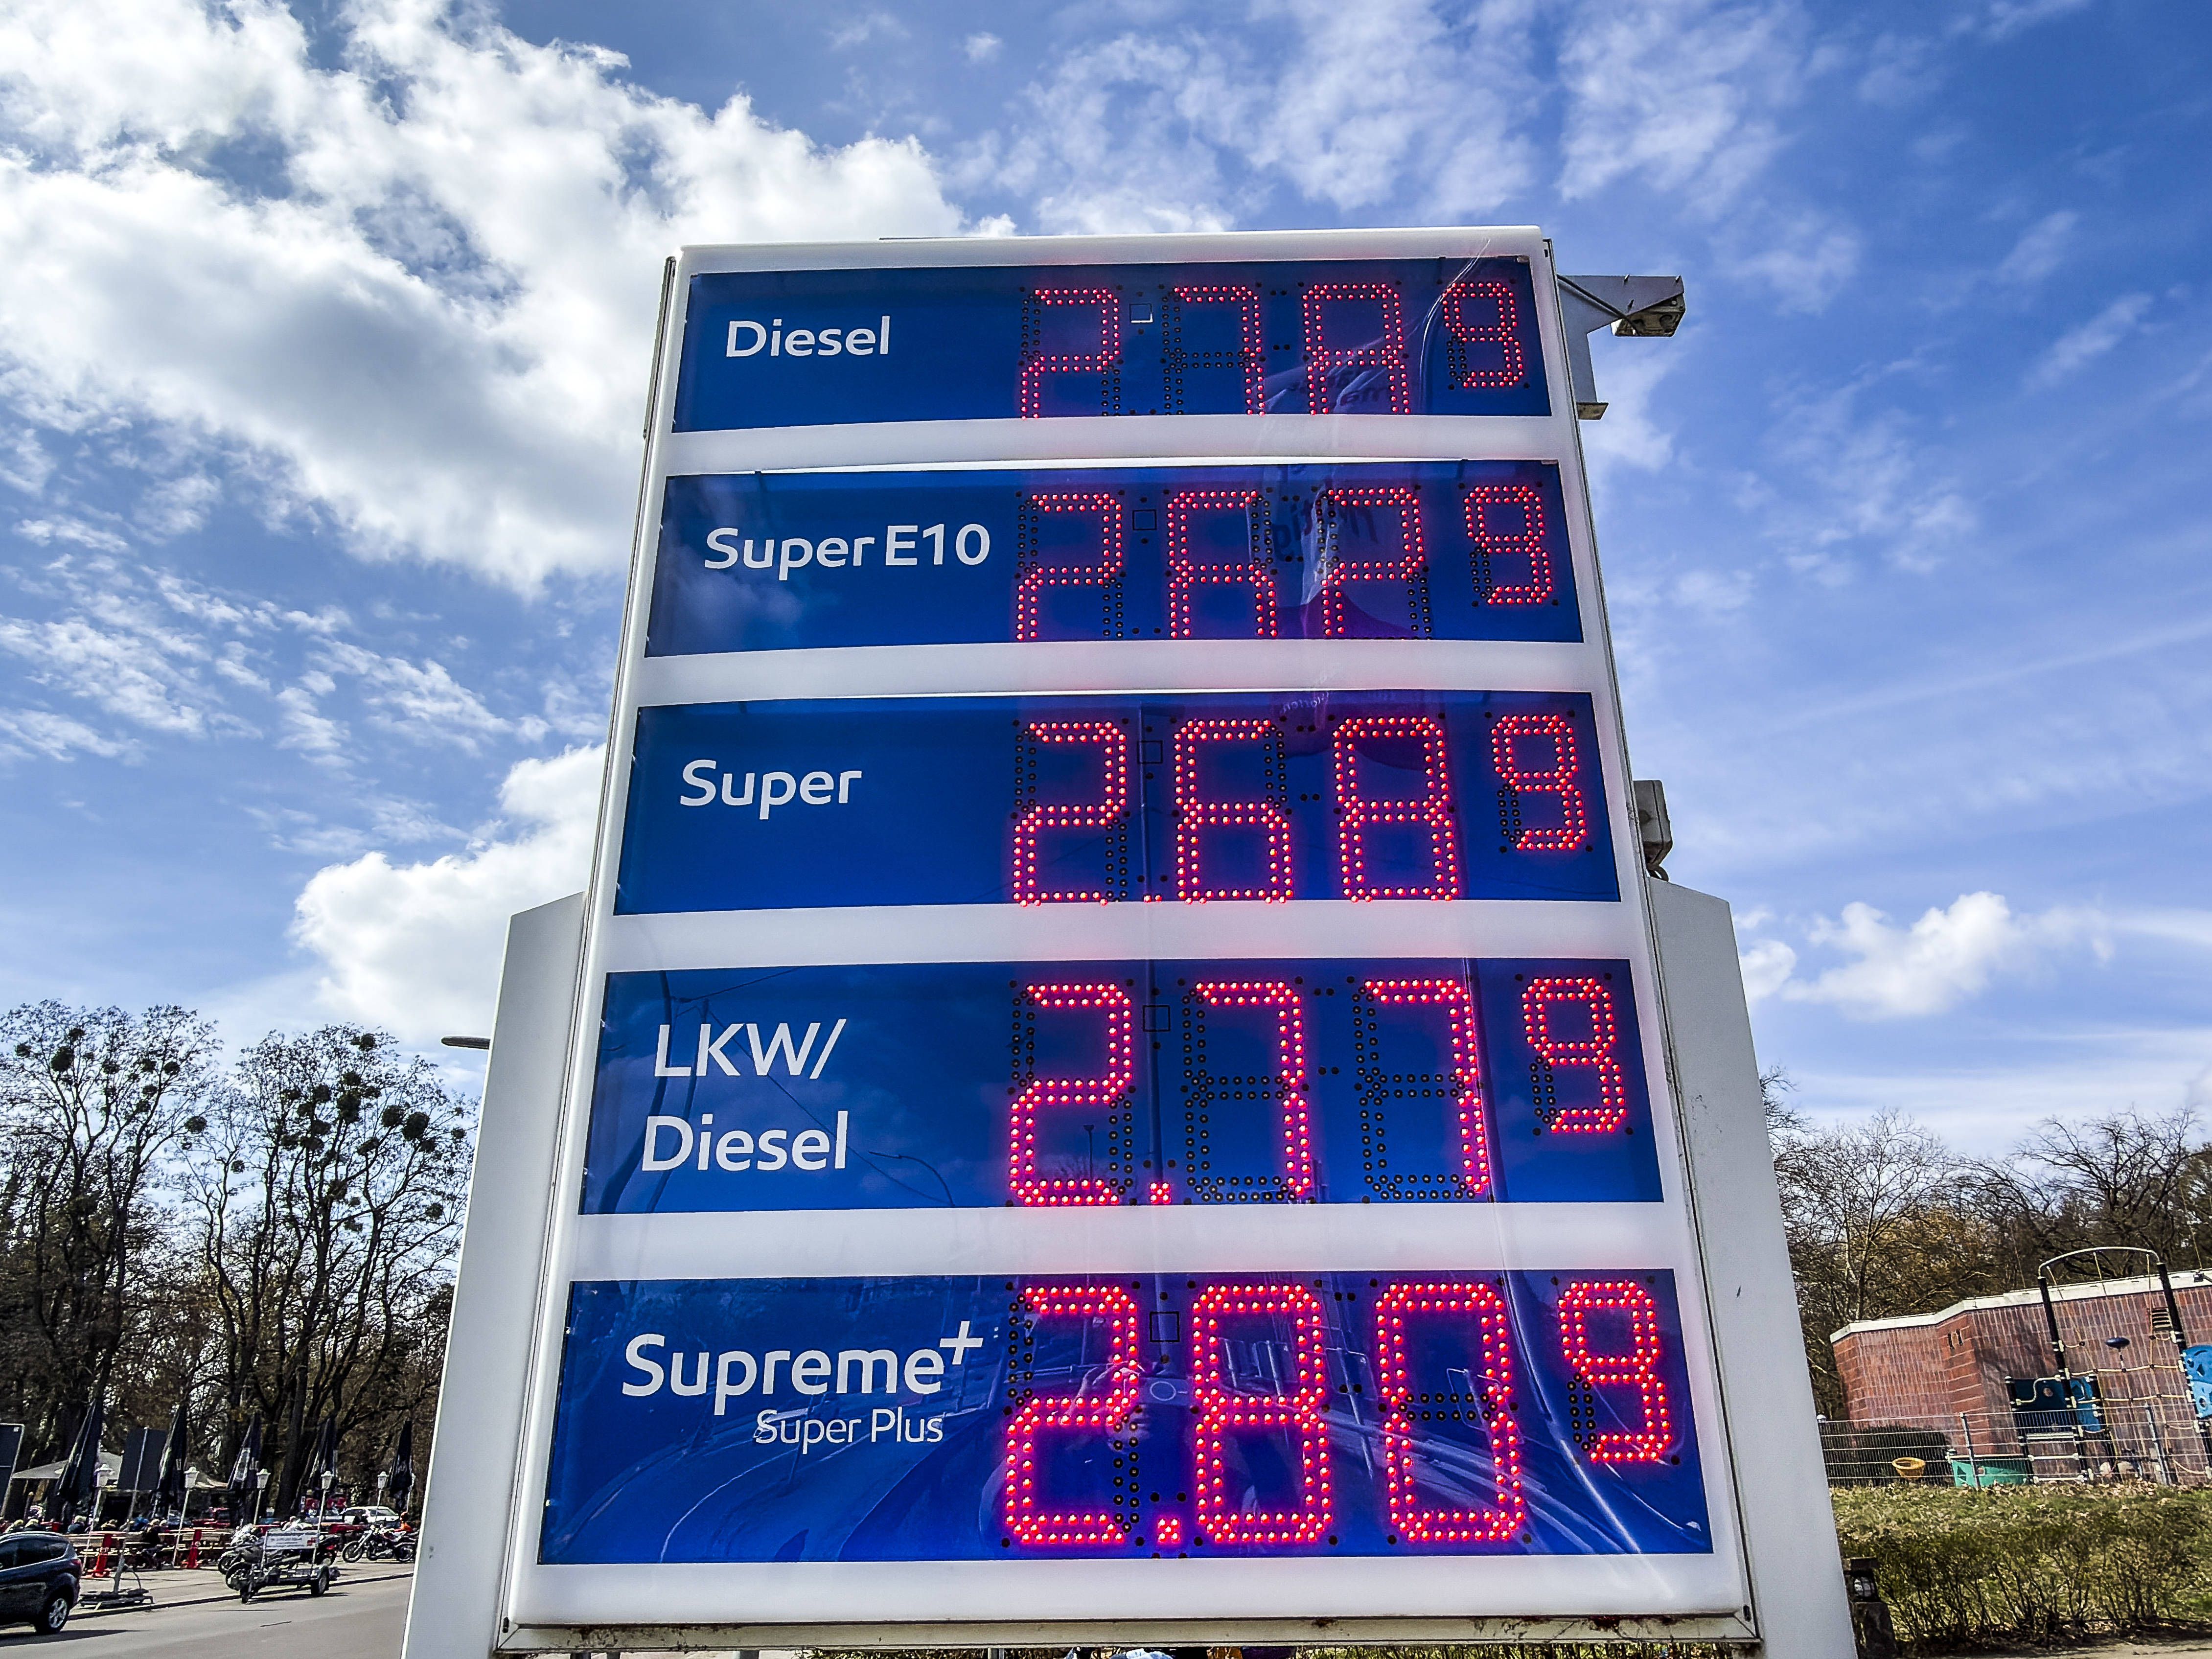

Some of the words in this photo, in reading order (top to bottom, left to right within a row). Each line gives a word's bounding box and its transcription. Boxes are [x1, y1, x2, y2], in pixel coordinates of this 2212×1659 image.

[727, 315, 890, 357] Diesel
[705, 527, 875, 581] Super
[885, 524, 990, 566] E10
[680, 759, 862, 820] Super
[654, 1018, 847, 1080] LKW/
[642, 1110, 849, 1171] Diesel
[755, 1409, 862, 1454] Super
[871, 1406, 944, 1443] Plus
